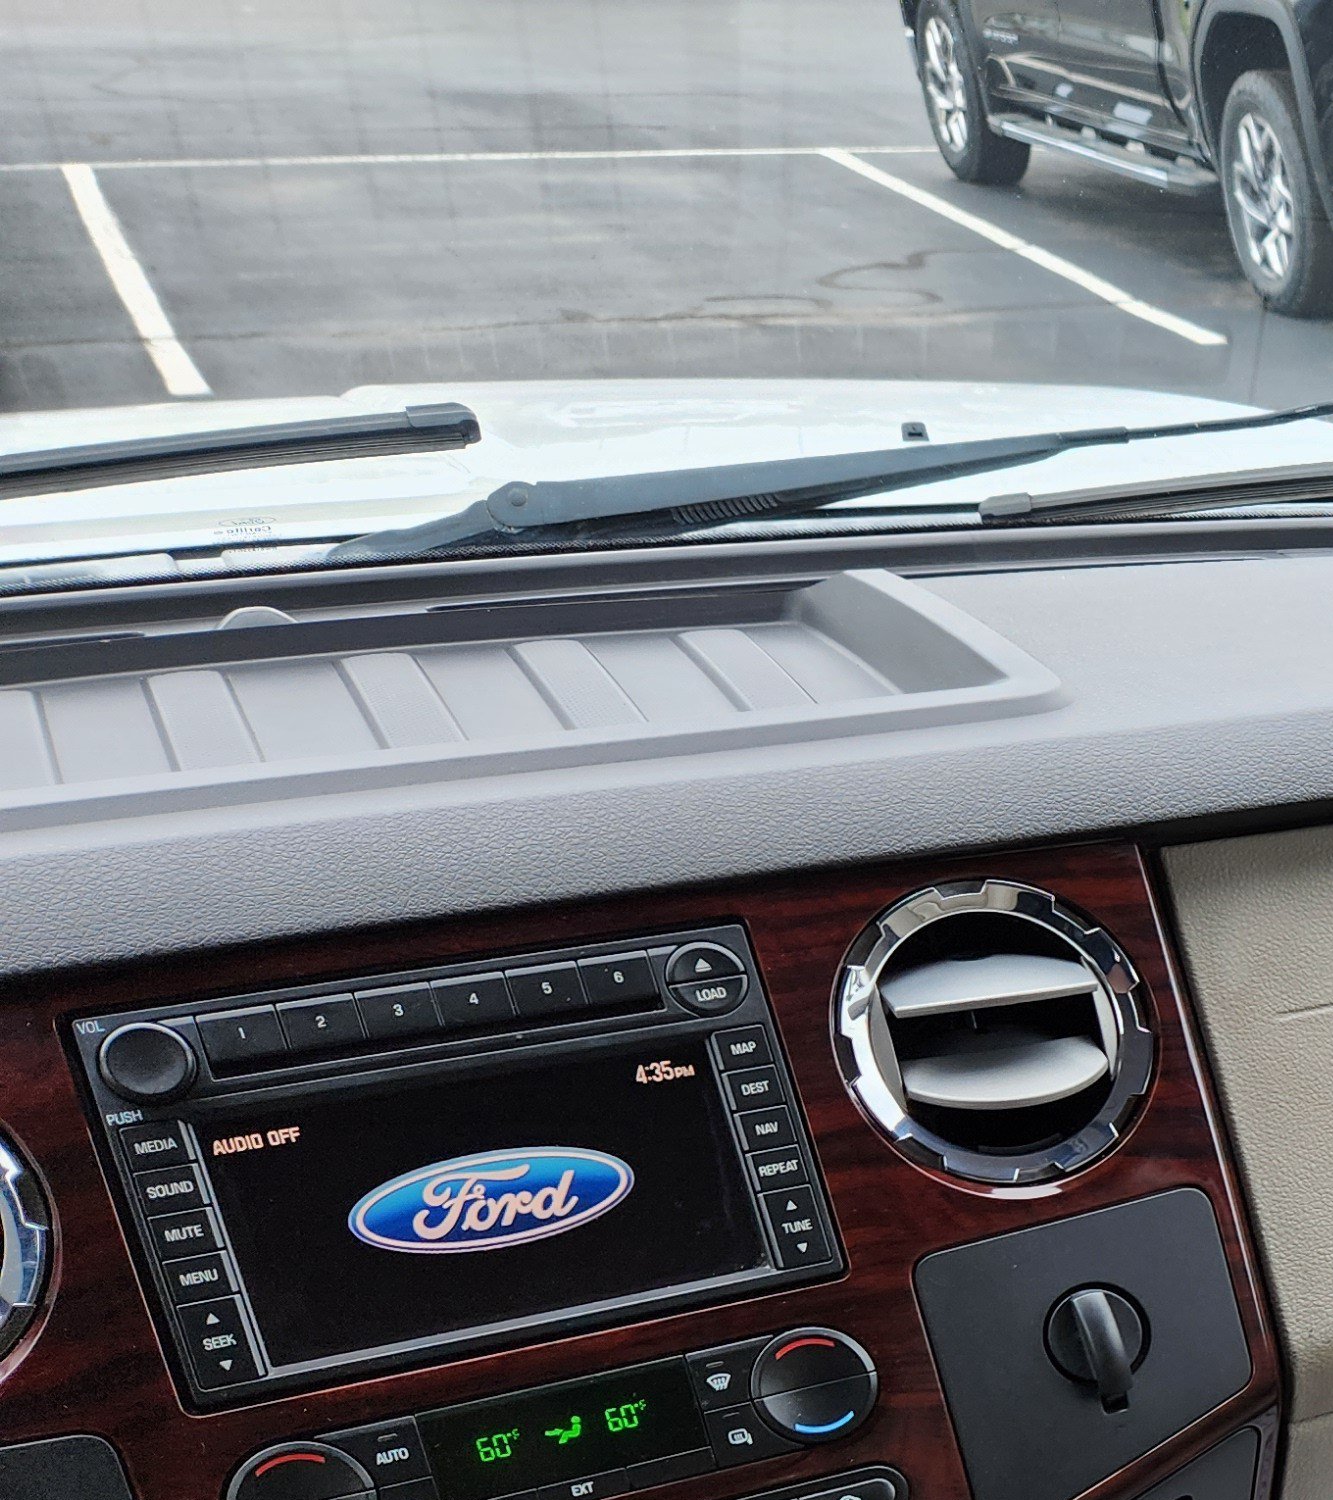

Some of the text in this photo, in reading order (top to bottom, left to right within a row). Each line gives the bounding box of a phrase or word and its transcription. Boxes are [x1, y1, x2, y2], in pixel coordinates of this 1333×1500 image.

[612, 971, 625, 985] 6
[541, 981, 553, 995] 5
[693, 985, 728, 1002] LOAD
[468, 992, 480, 1006] 4
[392, 1003, 405, 1017] 3
[76, 1019, 106, 1035] VOL
[314, 1015, 328, 1029] 2
[237, 1026, 246, 1040] 1
[729, 1040, 757, 1056] MAP
[740, 1079, 770, 1096] DEST
[105, 1109, 144, 1127] PUSH
[754, 1120, 780, 1136] NAV
[133, 1137, 178, 1156] MEDIA
[212, 1126, 301, 1156] AUDIO OFF
[758, 1159, 799, 1178] REPEAT
[146, 1180, 195, 1199] SOUND
[412, 1163, 579, 1240] Ford
[164, 1224, 205, 1242] MUTE
[781, 1218, 814, 1234] TUNE
[178, 1268, 219, 1287] MENU
[202, 1333, 238, 1351] SEEK
[375, 1446, 410, 1466] AUTO
[570, 1480, 595, 1497] EXT
